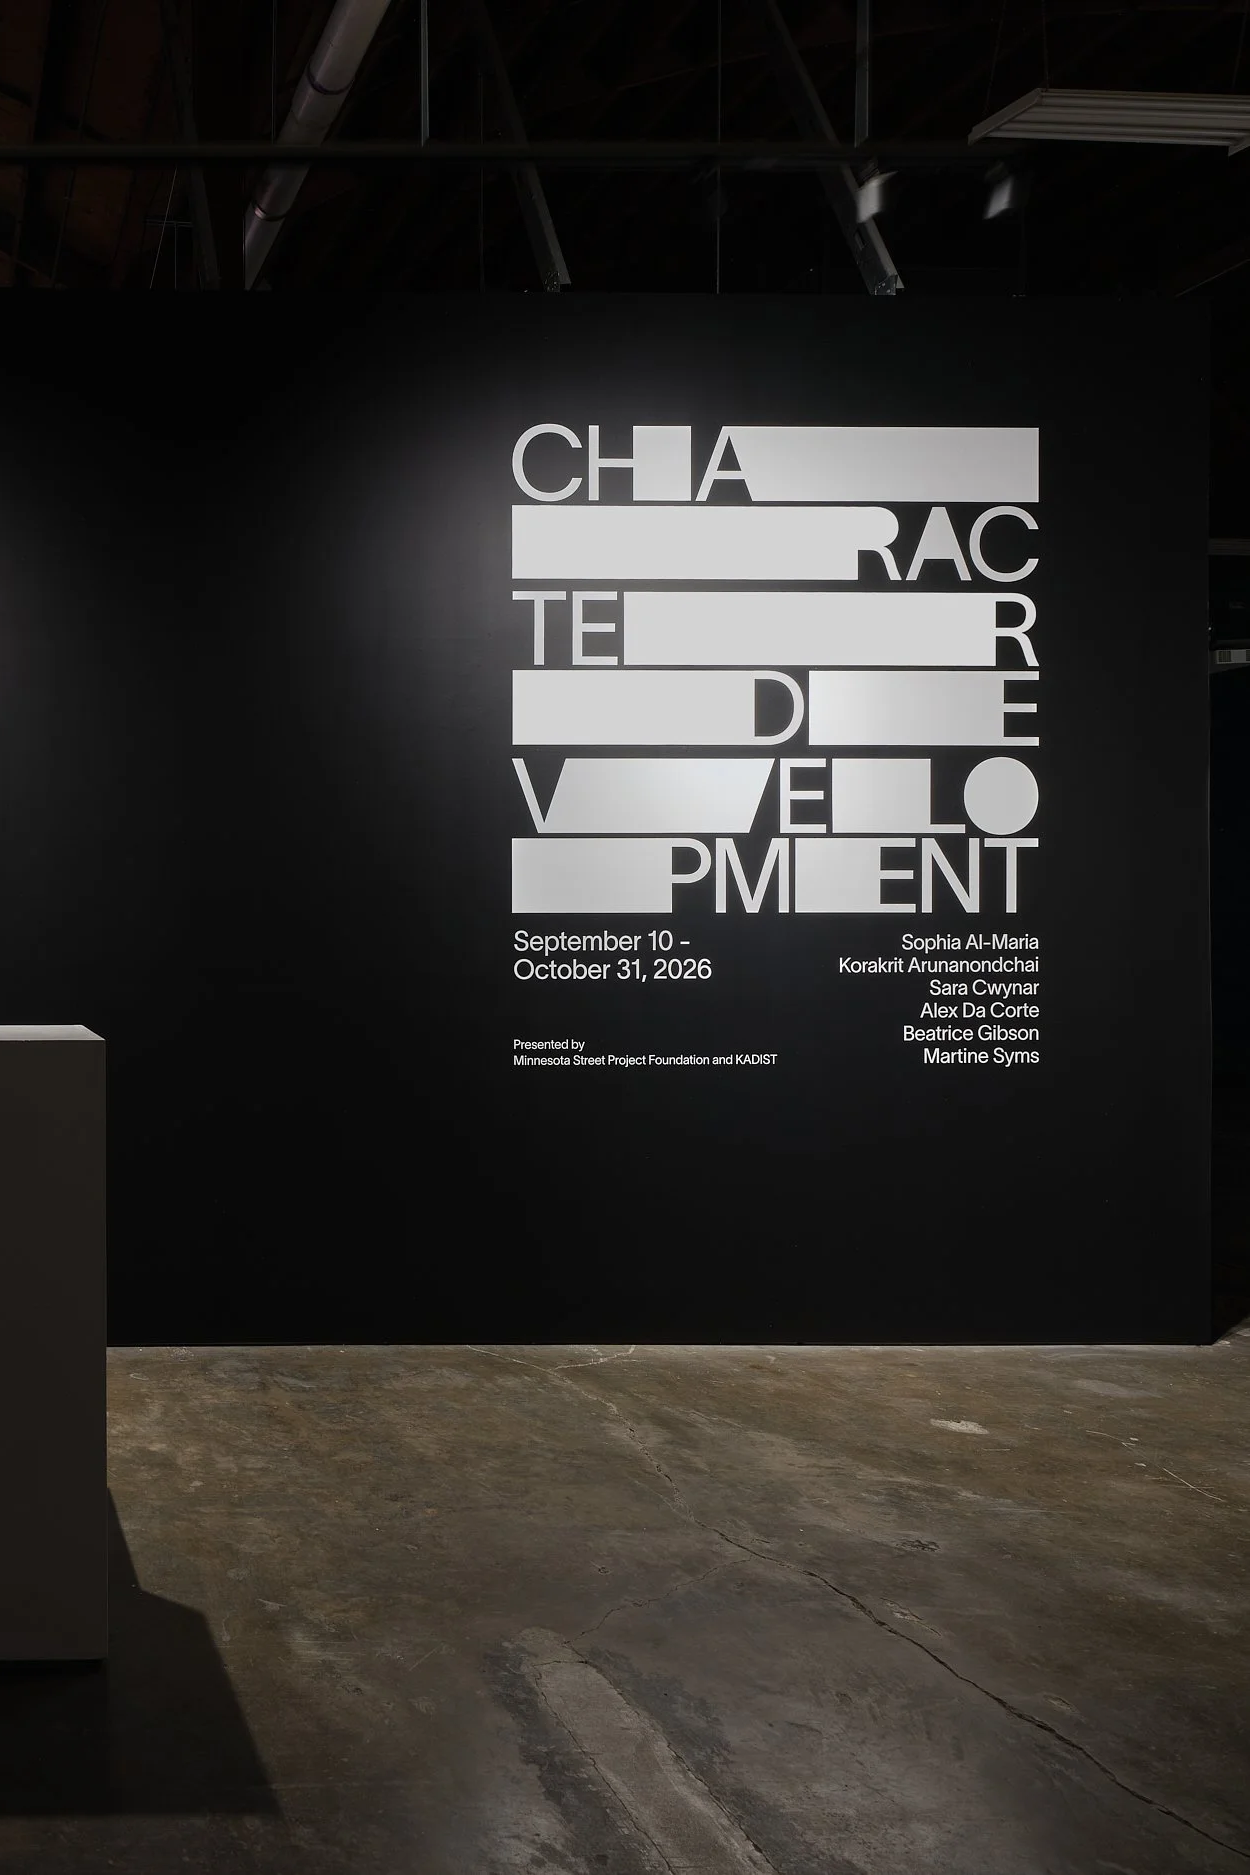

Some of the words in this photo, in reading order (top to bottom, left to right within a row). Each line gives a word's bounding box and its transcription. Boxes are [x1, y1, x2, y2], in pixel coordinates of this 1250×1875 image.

[513, 929, 642, 956] September
[647, 929, 674, 952] 10
[901, 933, 962, 954] Sophia
[964, 933, 1040, 951] Al-Maria
[513, 958, 611, 981] October
[616, 958, 648, 983] 31,
[653, 958, 713, 981] 2026
[839, 956, 905, 974] Korakrit
[907, 956, 1040, 974] Arunanondchai
[929, 978, 969, 996] Sara
[972, 978, 1040, 999] Cwynar
[919, 1001, 959, 1019] Alex
[962, 1001, 987, 1019] Da
[990, 1001, 1040, 1019] Corte
[903, 1024, 975, 1042] Beatrice
[977, 1024, 1040, 1042] Gibson
[513, 1039, 569, 1051] Presented
[571, 1039, 586, 1052] by
[513, 1054, 571, 1067] Minnesota
[572, 1054, 606, 1067] Street
[607, 1054, 647, 1068] Project
[648, 1054, 711, 1066] Foundation
[711, 1054, 734, 1066] and
[735, 1053, 779, 1066] KADIST
[923, 1047, 990, 1065] Martine
[992, 1047, 1040, 1068] Syms
